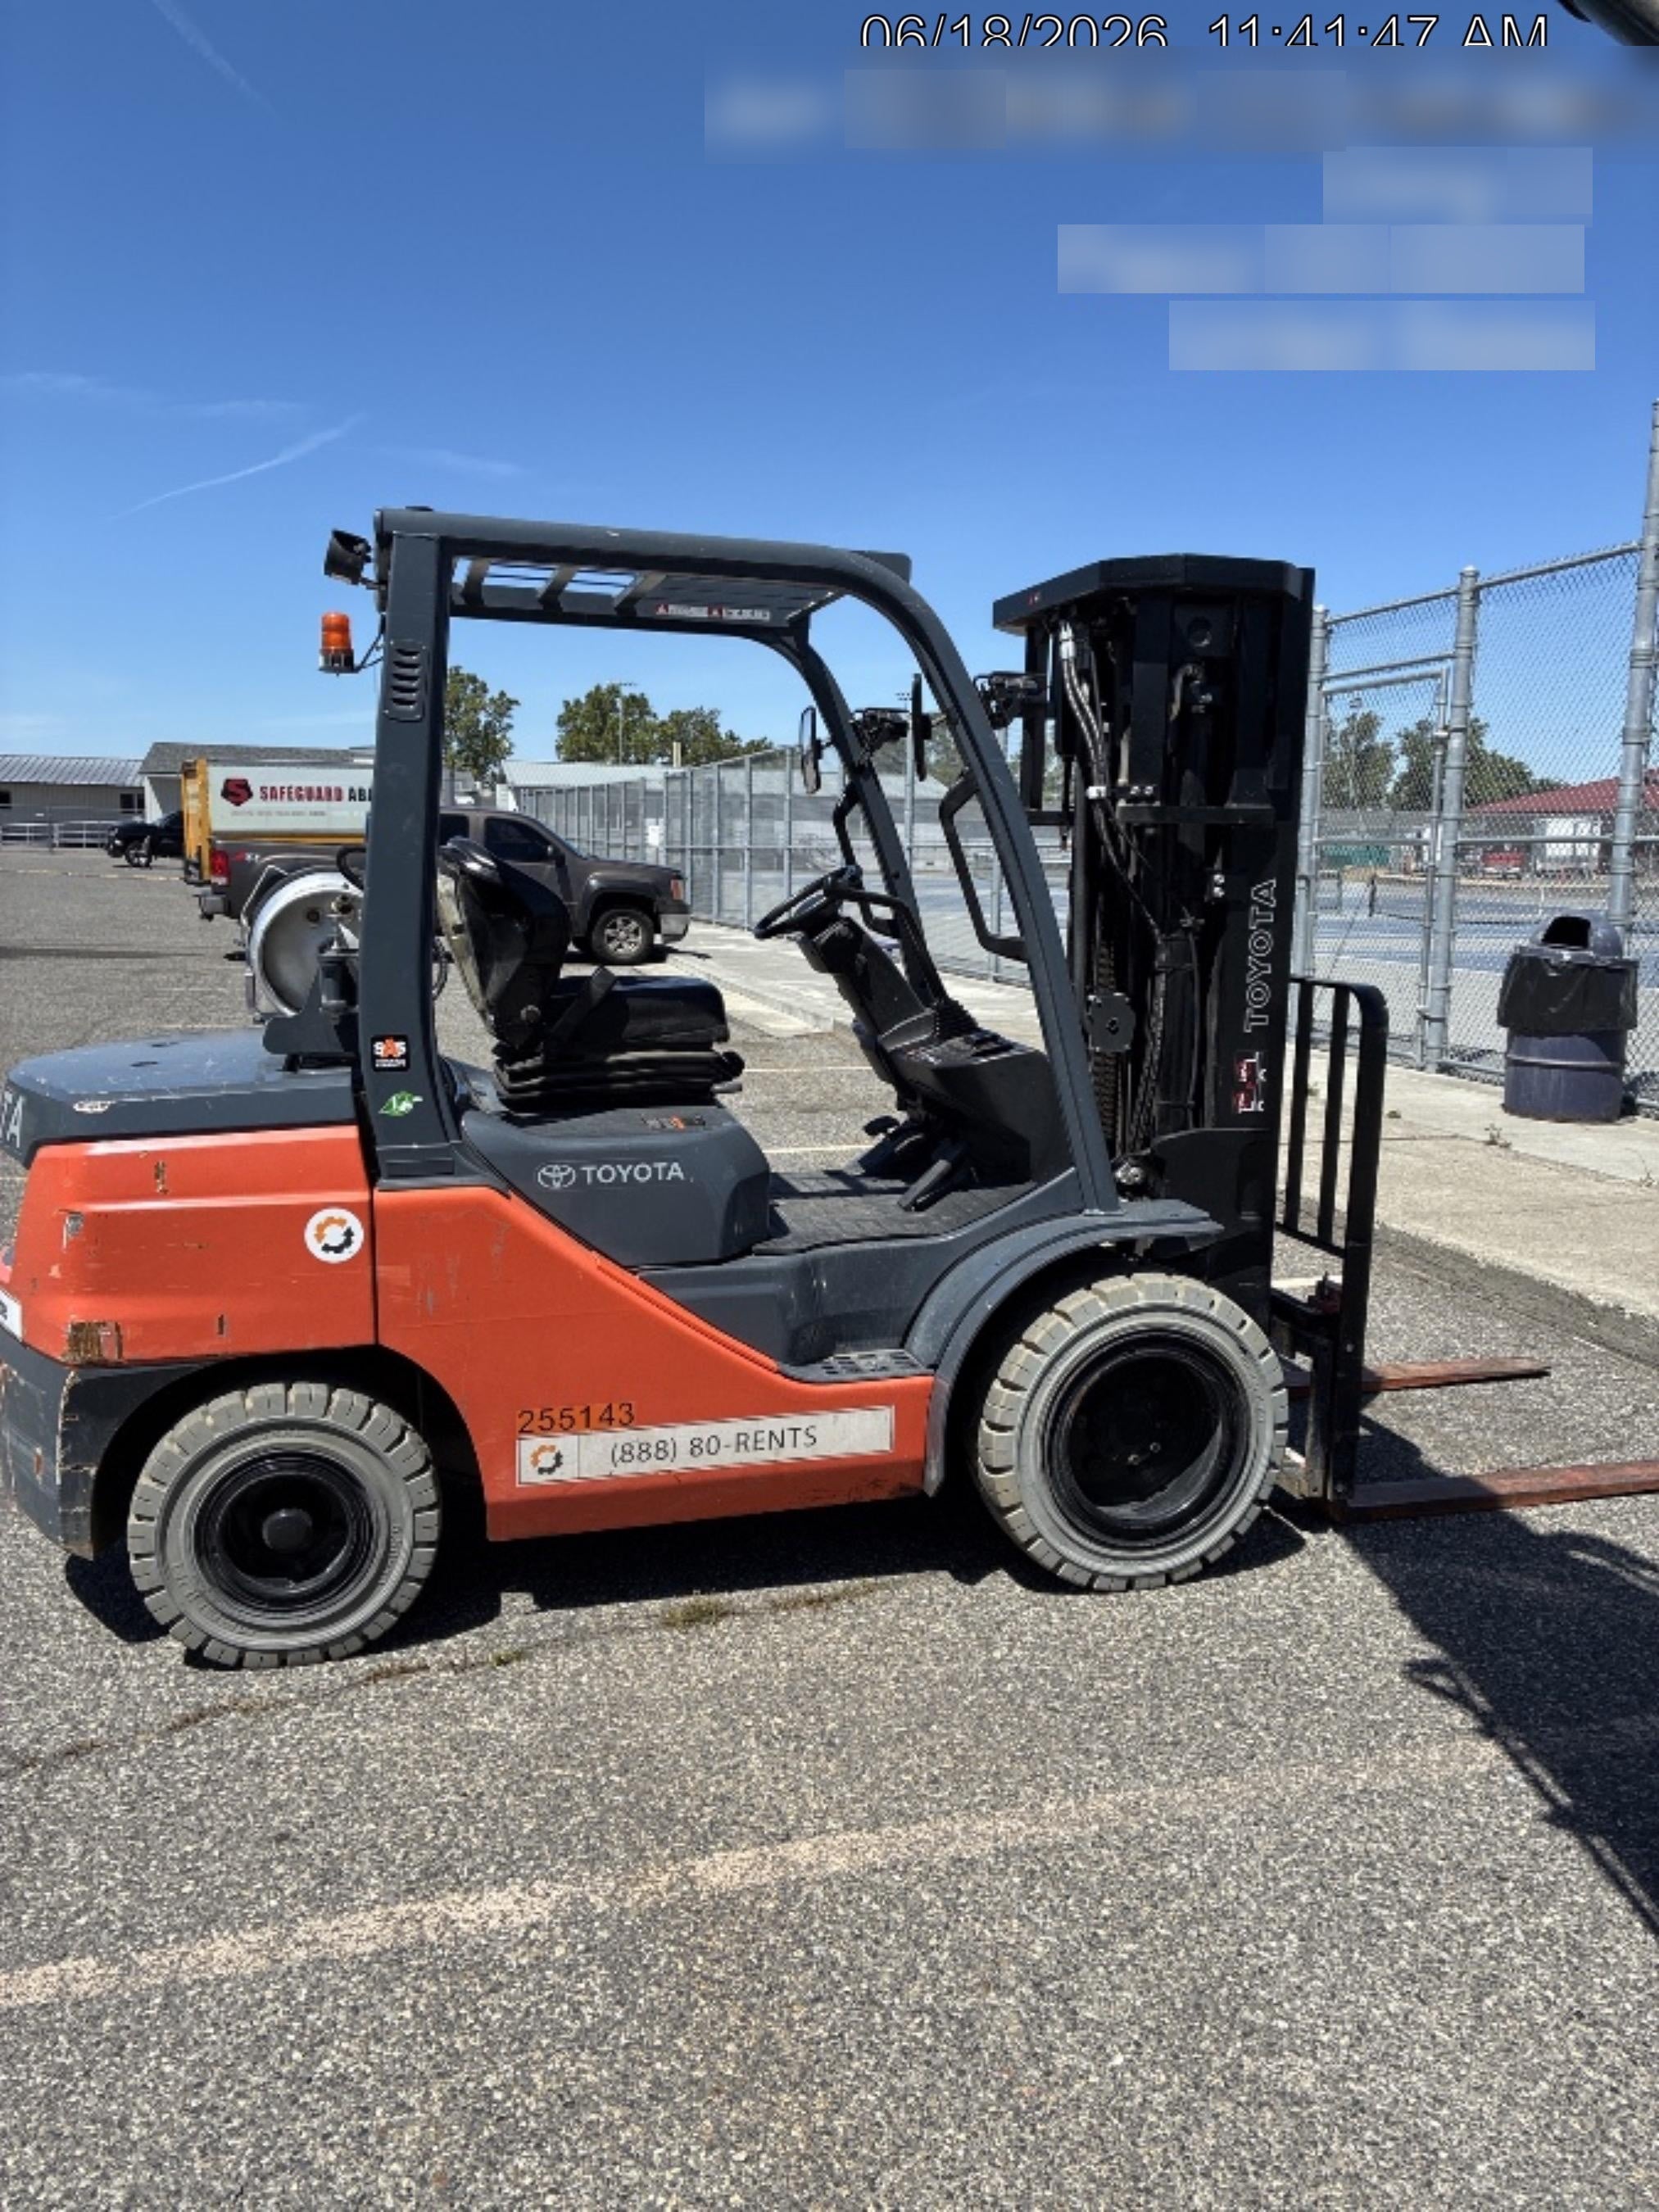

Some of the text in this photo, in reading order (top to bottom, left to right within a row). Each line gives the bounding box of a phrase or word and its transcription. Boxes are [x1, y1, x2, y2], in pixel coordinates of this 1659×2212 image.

[259, 786, 343, 803] SAFEGUARD
[1244, 877, 1277, 1034] TOYOTA
[580, 1162, 685, 1185] TOYOTA
[518, 1402, 635, 1435] 255143
[610, 1425, 818, 1466] (888) 80-RENTS
